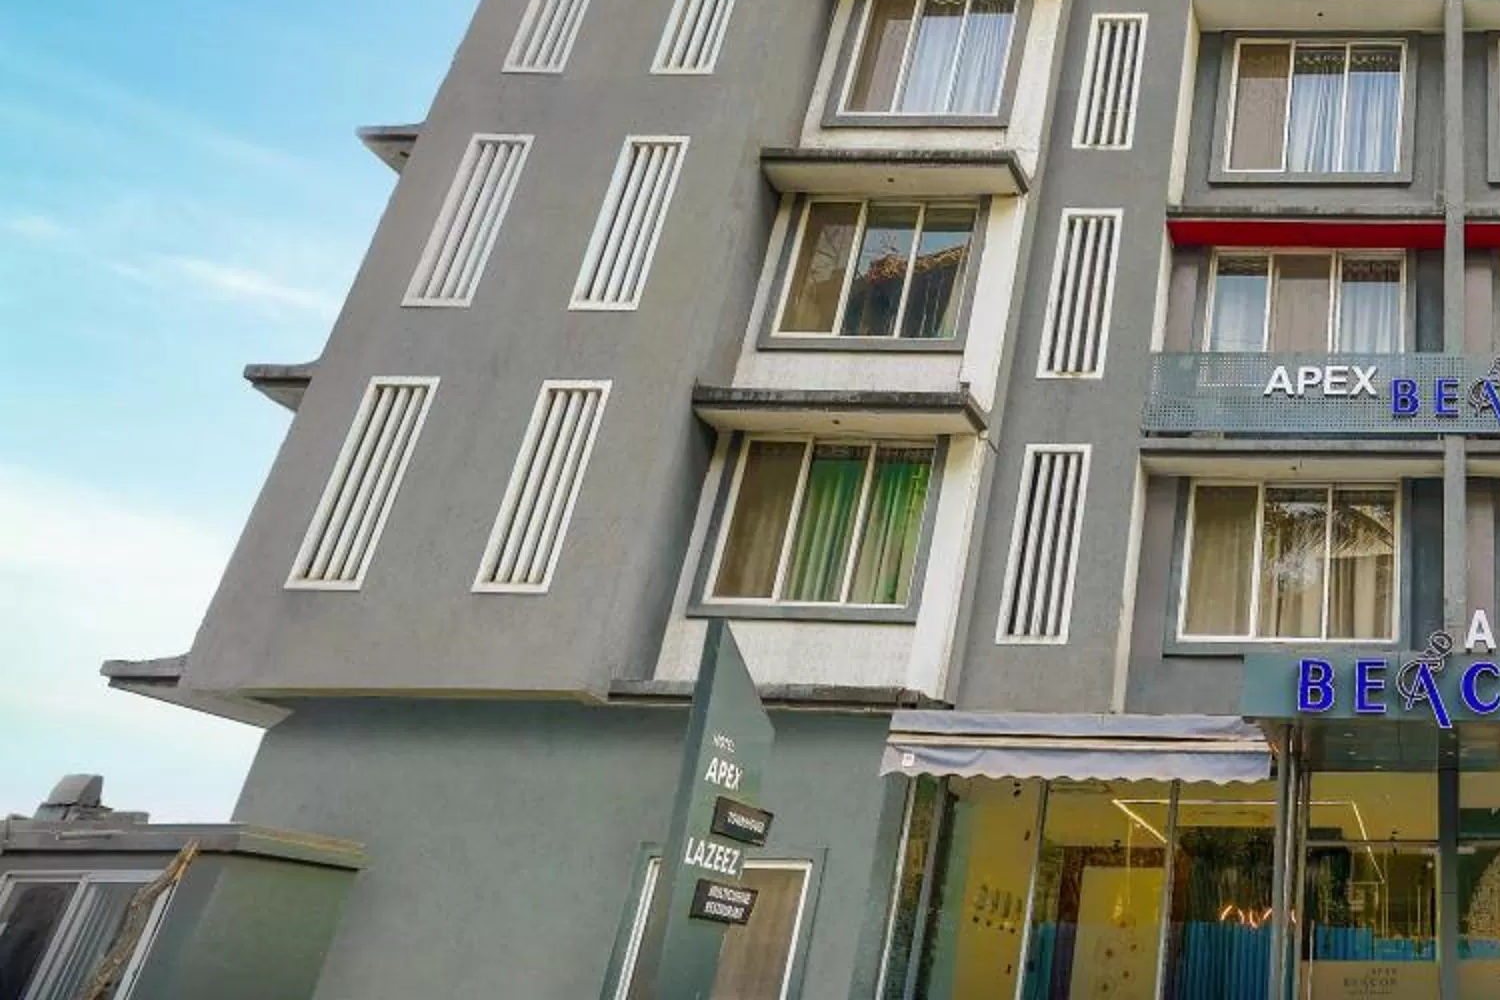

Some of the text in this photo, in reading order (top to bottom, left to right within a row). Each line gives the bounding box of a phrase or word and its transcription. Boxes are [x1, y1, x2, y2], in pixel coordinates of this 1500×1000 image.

[1264, 365, 1379, 398] APEX
[704, 756, 744, 792] APEX
[683, 836, 741, 875] LAZEEZ
